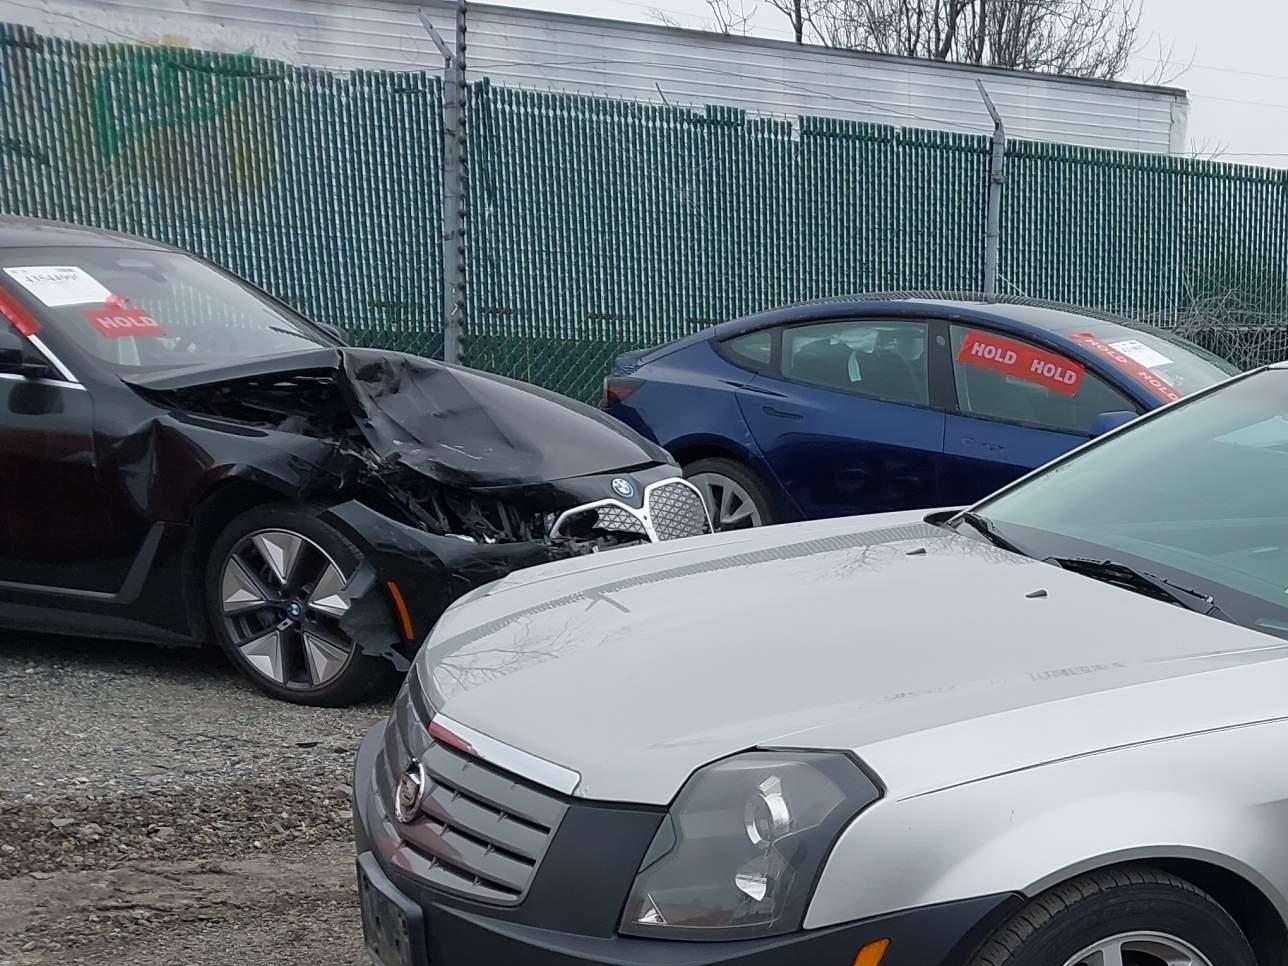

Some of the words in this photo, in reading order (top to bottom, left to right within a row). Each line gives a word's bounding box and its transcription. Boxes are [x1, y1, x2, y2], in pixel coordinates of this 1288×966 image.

[96, 316, 159, 328] HOLD
[972, 343, 1016, 365] HOLD
[1031, 359, 1076, 385] HOLD
[1085, 339, 1128, 363] HOLD
[1138, 371, 1178, 400] HOLD
